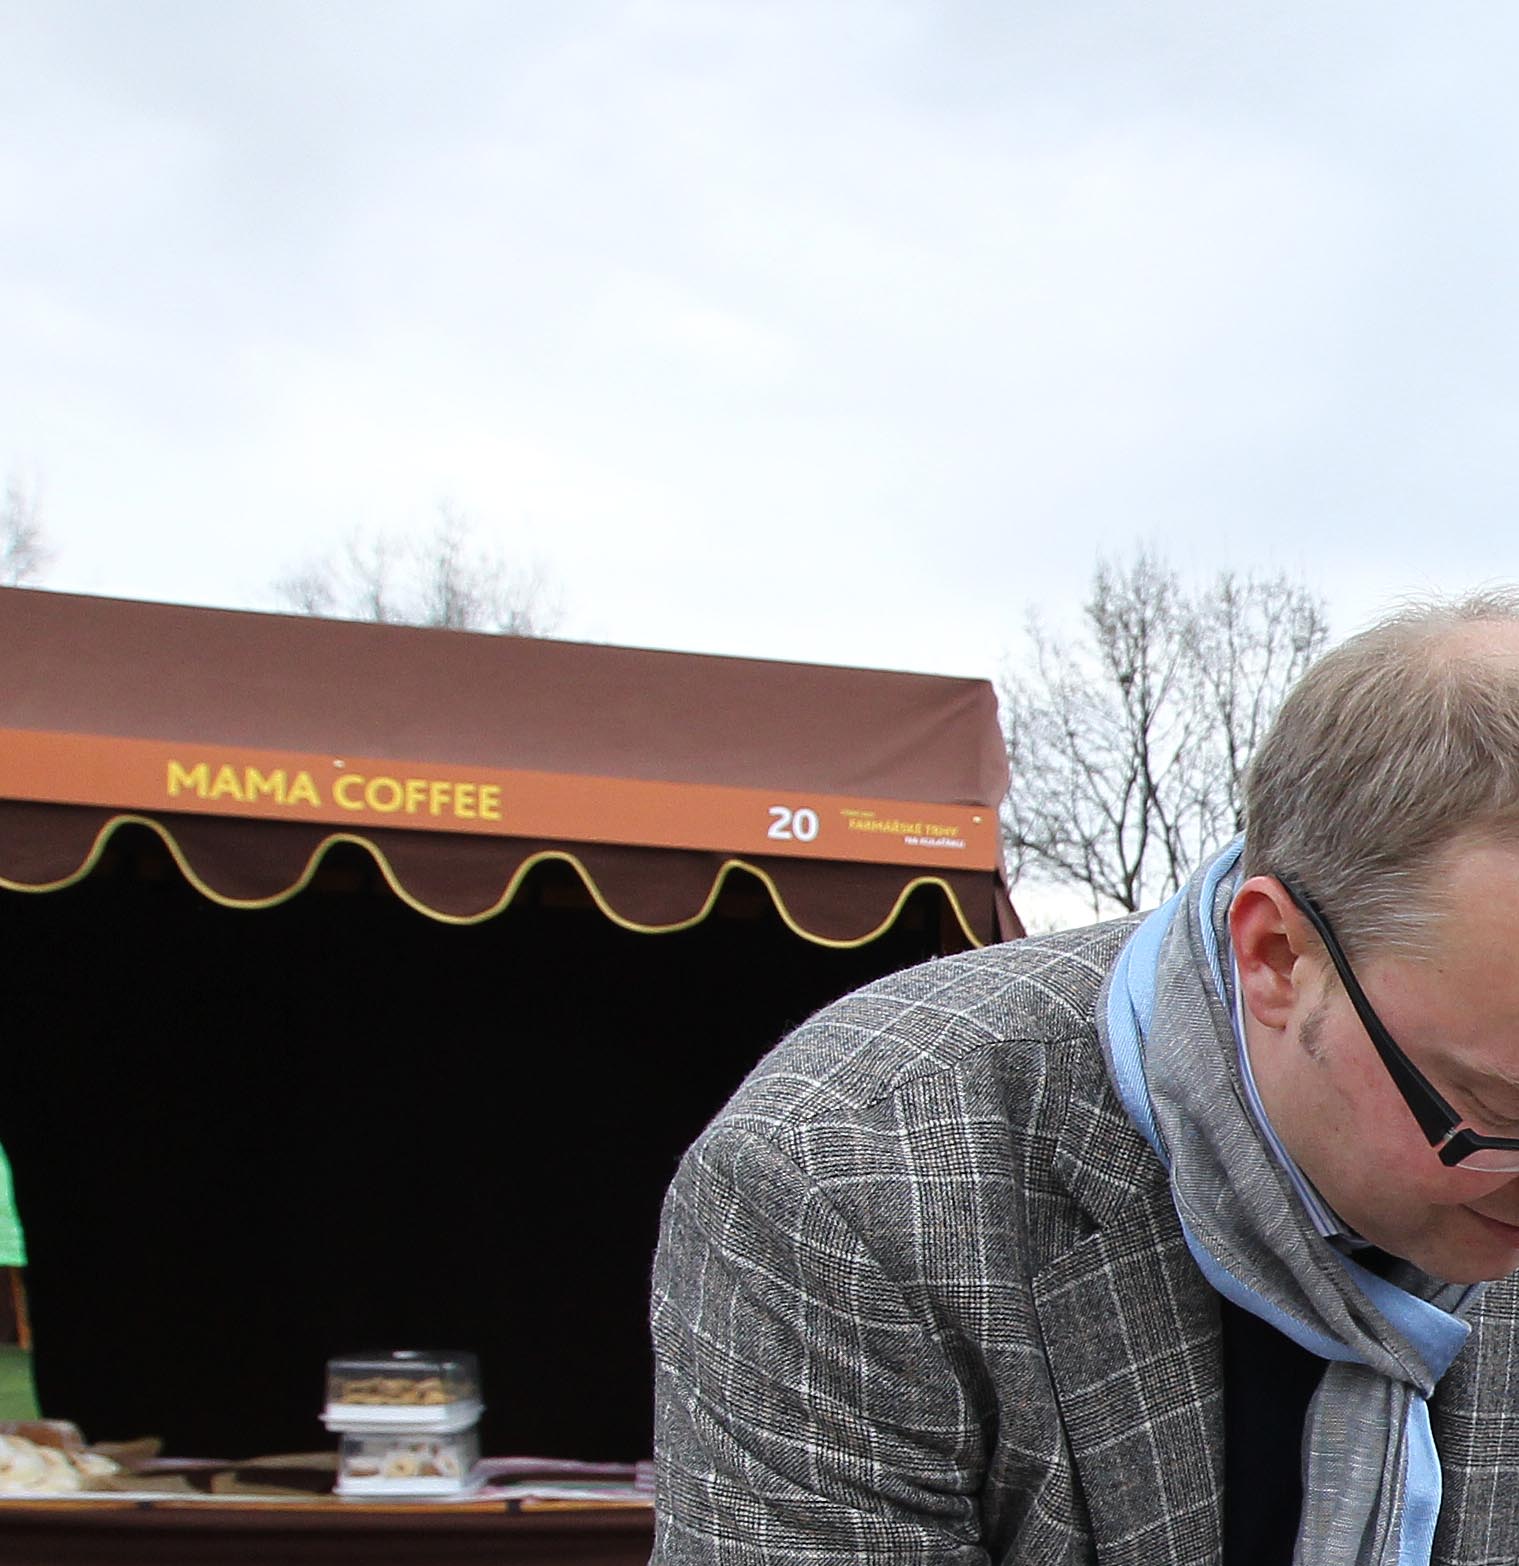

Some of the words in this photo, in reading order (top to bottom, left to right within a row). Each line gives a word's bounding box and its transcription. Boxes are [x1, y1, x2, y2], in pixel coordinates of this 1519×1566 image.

[167, 759, 322, 808] MAMA
[332, 773, 503, 821] COFFEE
[767, 805, 821, 842] 20
